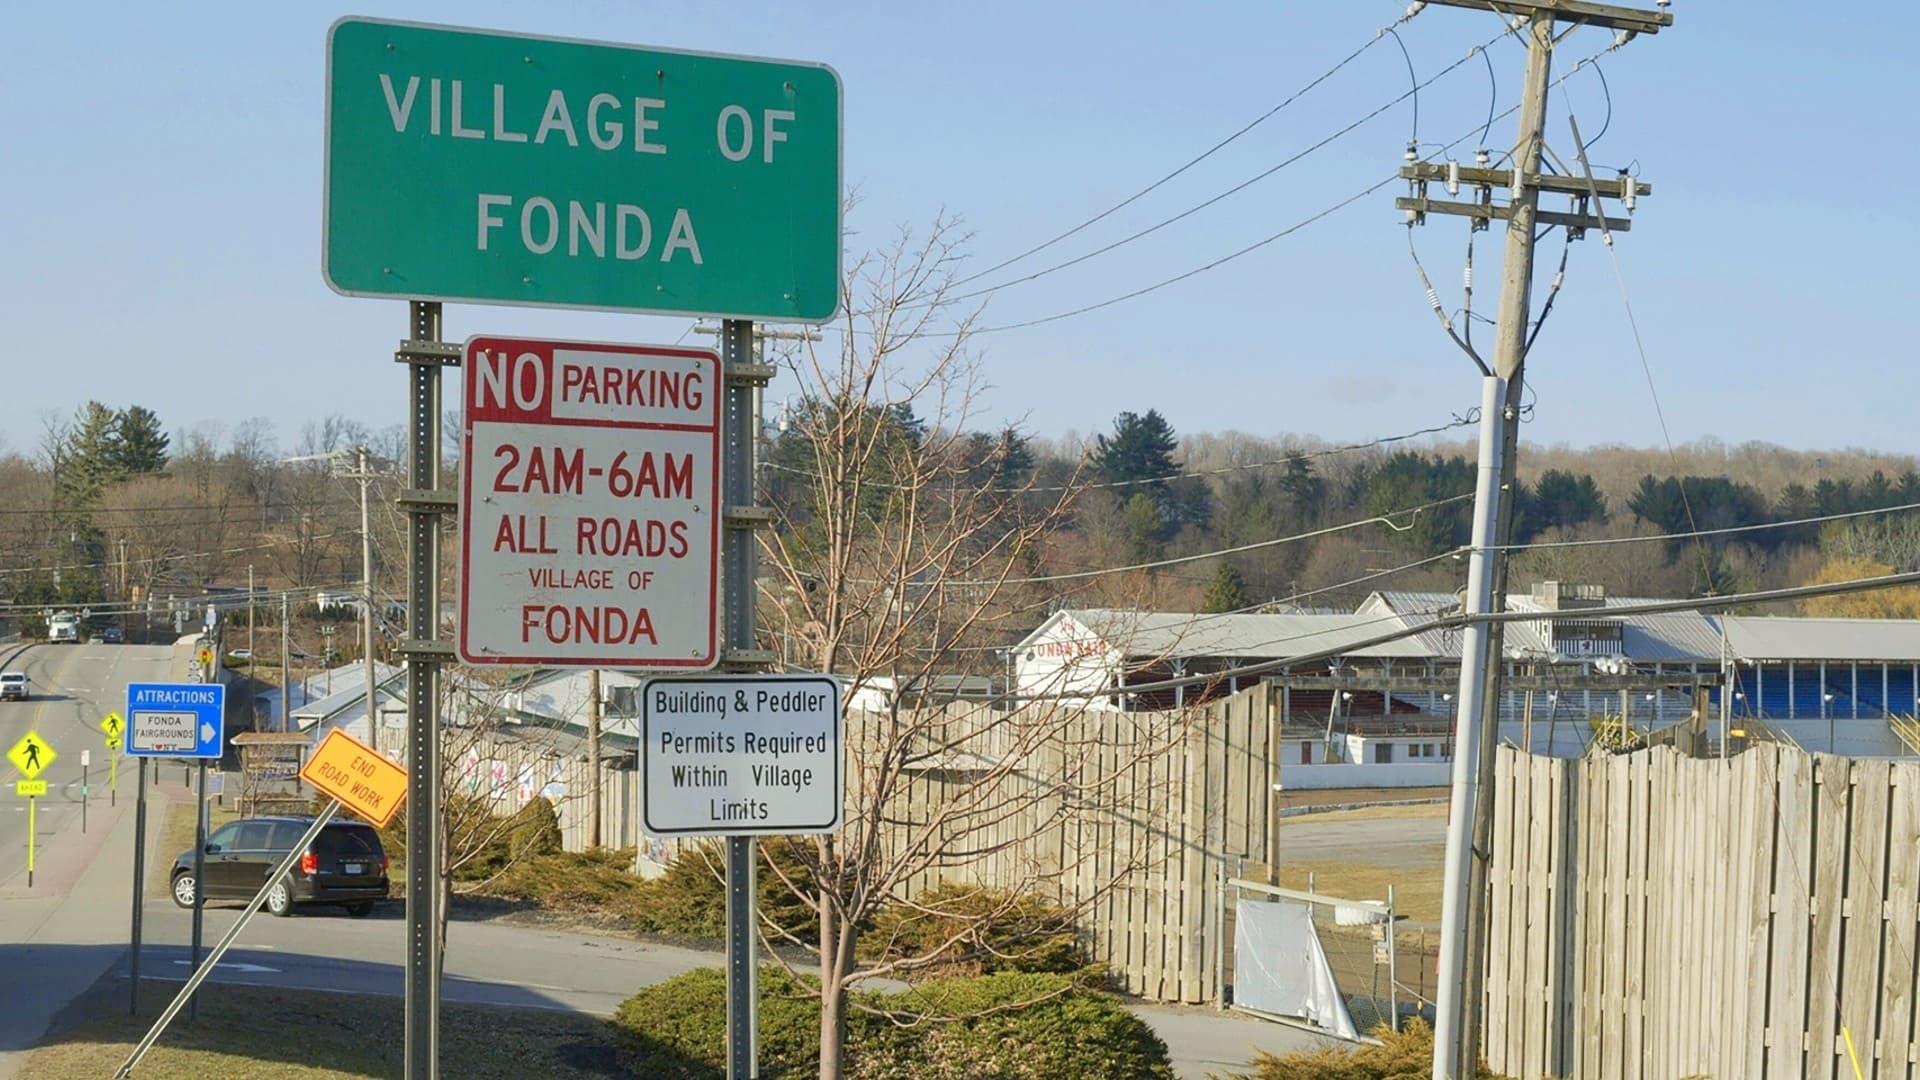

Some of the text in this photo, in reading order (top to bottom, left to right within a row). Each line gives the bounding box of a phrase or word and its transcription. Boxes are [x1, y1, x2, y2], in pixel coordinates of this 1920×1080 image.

[378, 73, 796, 164] VILLAGE OF
[476, 193, 704, 265] FONDA
[474, 351, 703, 412] NO PARKING
[493, 444, 694, 500] 2AM-6AM
[493, 515, 689, 559] ALL ROADS
[528, 568, 655, 590] VILLAGE OF
[521, 604, 658, 645] FONDA
[136, 690, 216, 704] ATTRACTIONS
[655, 689, 826, 720] Building & Peddler
[135, 728, 195, 738] FAIRGROUNDS
[147, 716, 182, 726] FONDA
[661, 731, 826, 759] Permits Required
[350, 755, 377, 778] END
[672, 764, 813, 792] Within Village
[318, 761, 350, 787] ROAD
[349, 780, 385, 810] WORK
[711, 798, 769, 821] Limits
